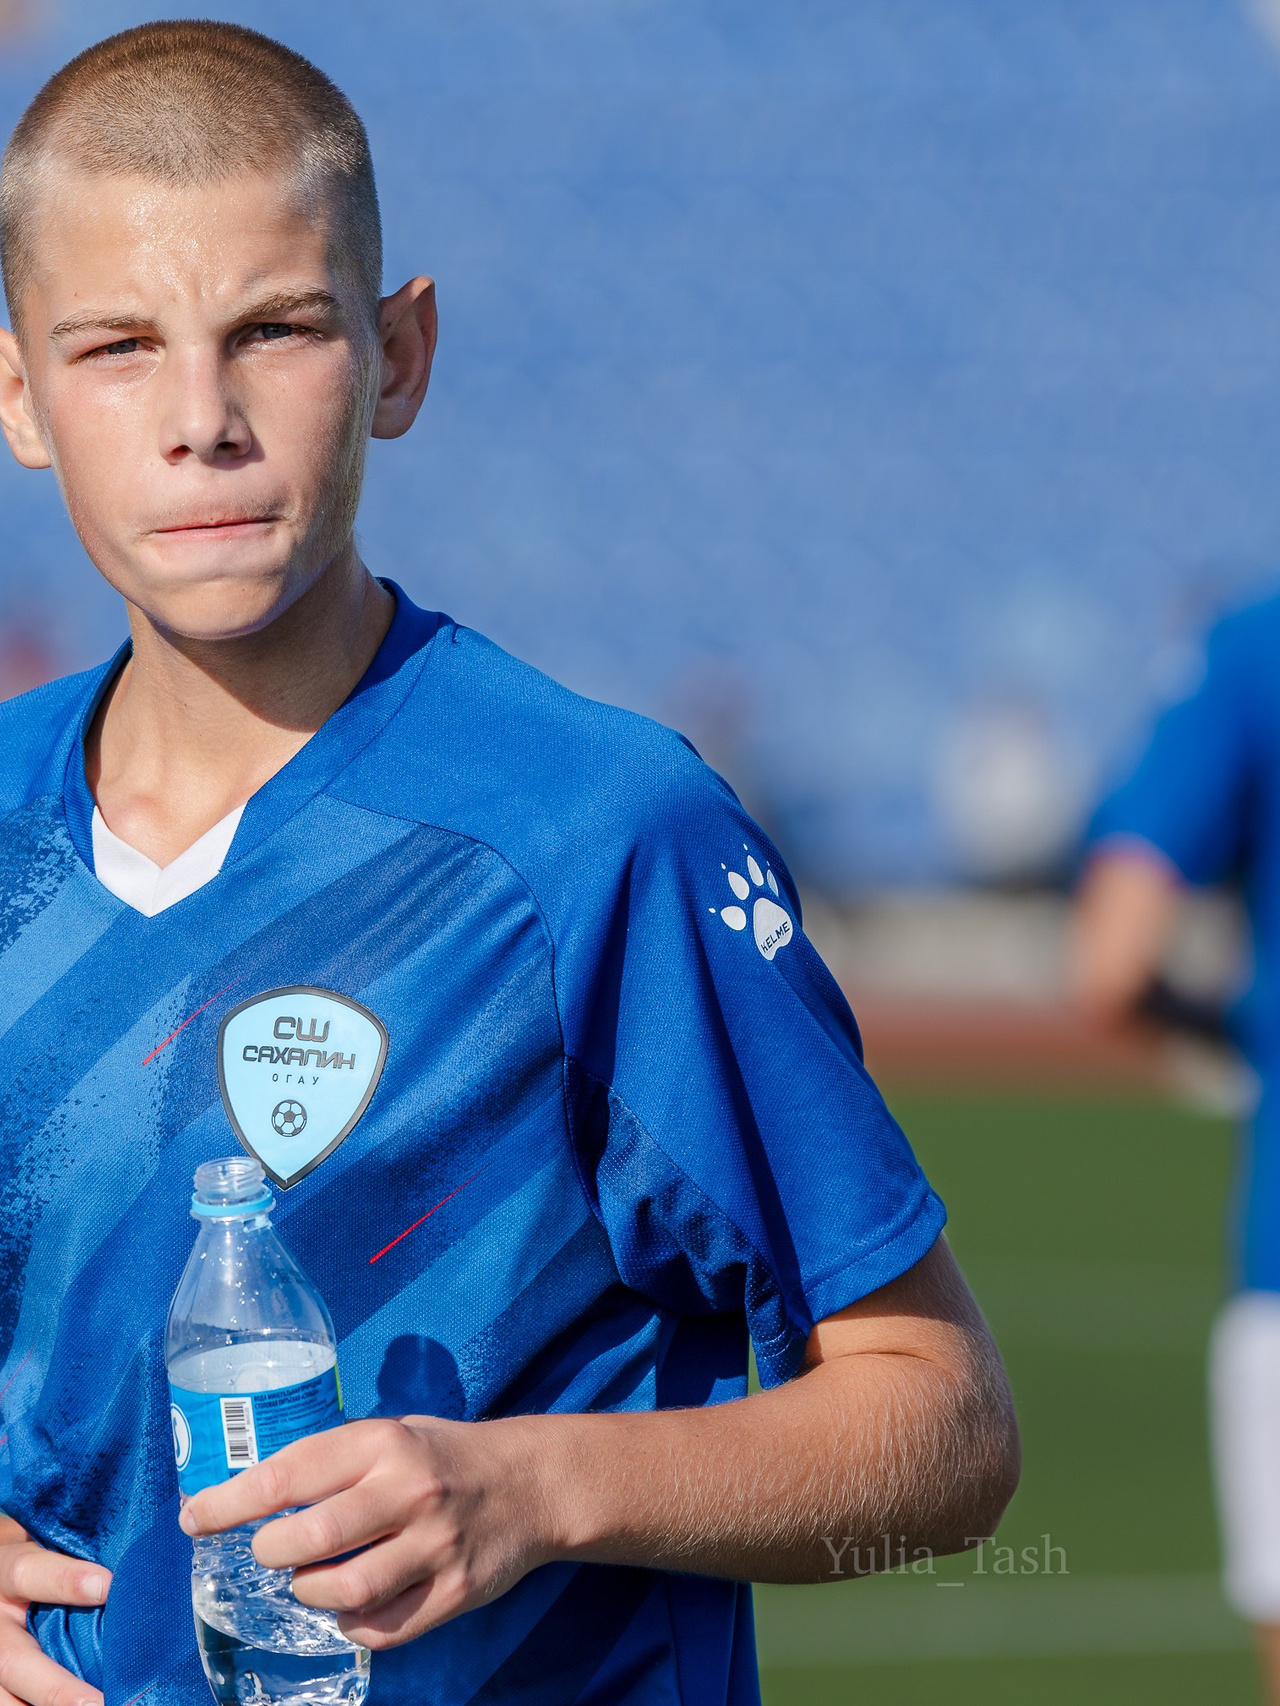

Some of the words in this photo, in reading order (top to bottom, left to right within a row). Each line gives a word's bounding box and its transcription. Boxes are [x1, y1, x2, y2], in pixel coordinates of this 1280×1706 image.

[760, 921, 790, 953] KELME
[273, 1016, 330, 1043] СШ
[242, 1045, 356, 1070] САХАЛИН
